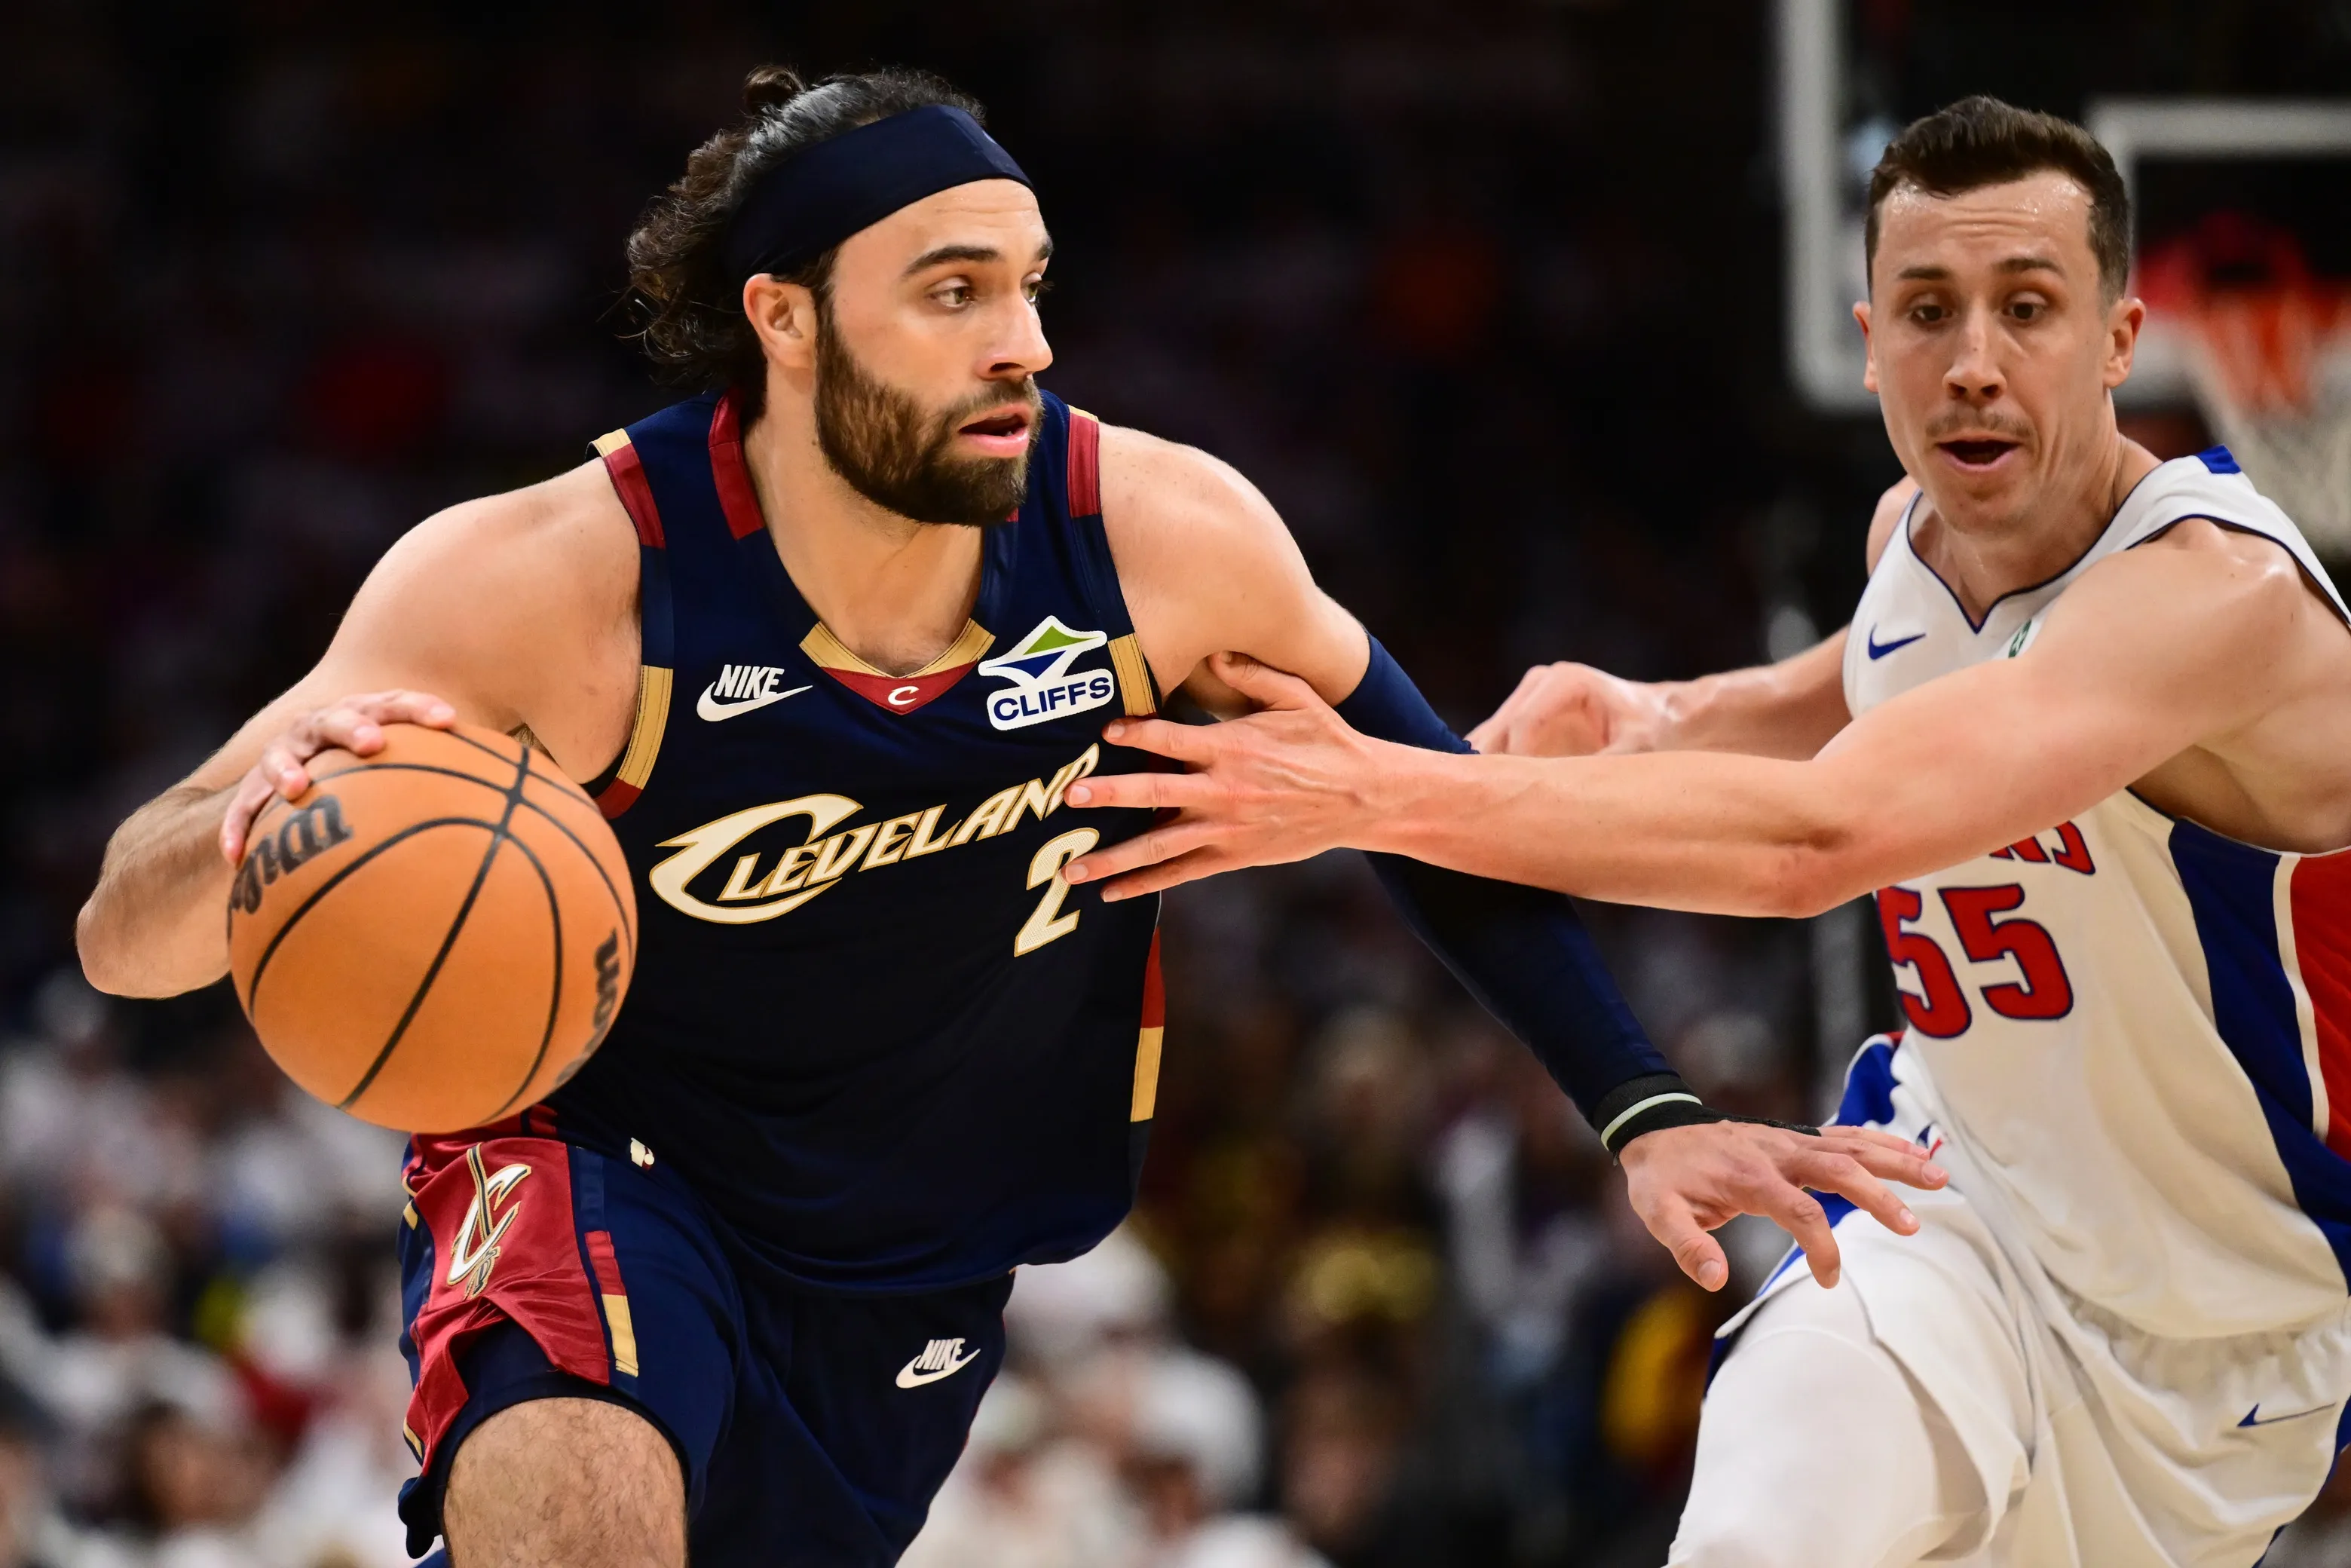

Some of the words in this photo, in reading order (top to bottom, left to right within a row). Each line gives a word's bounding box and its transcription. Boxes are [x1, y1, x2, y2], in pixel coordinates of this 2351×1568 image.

[714, 664, 785, 699] NIKE
[993, 677, 1111, 721] CLIFFS
[1014, 827, 1100, 957] 2
[1876, 883, 2074, 1039] 55
[914, 1337, 966, 1370] NIKE
